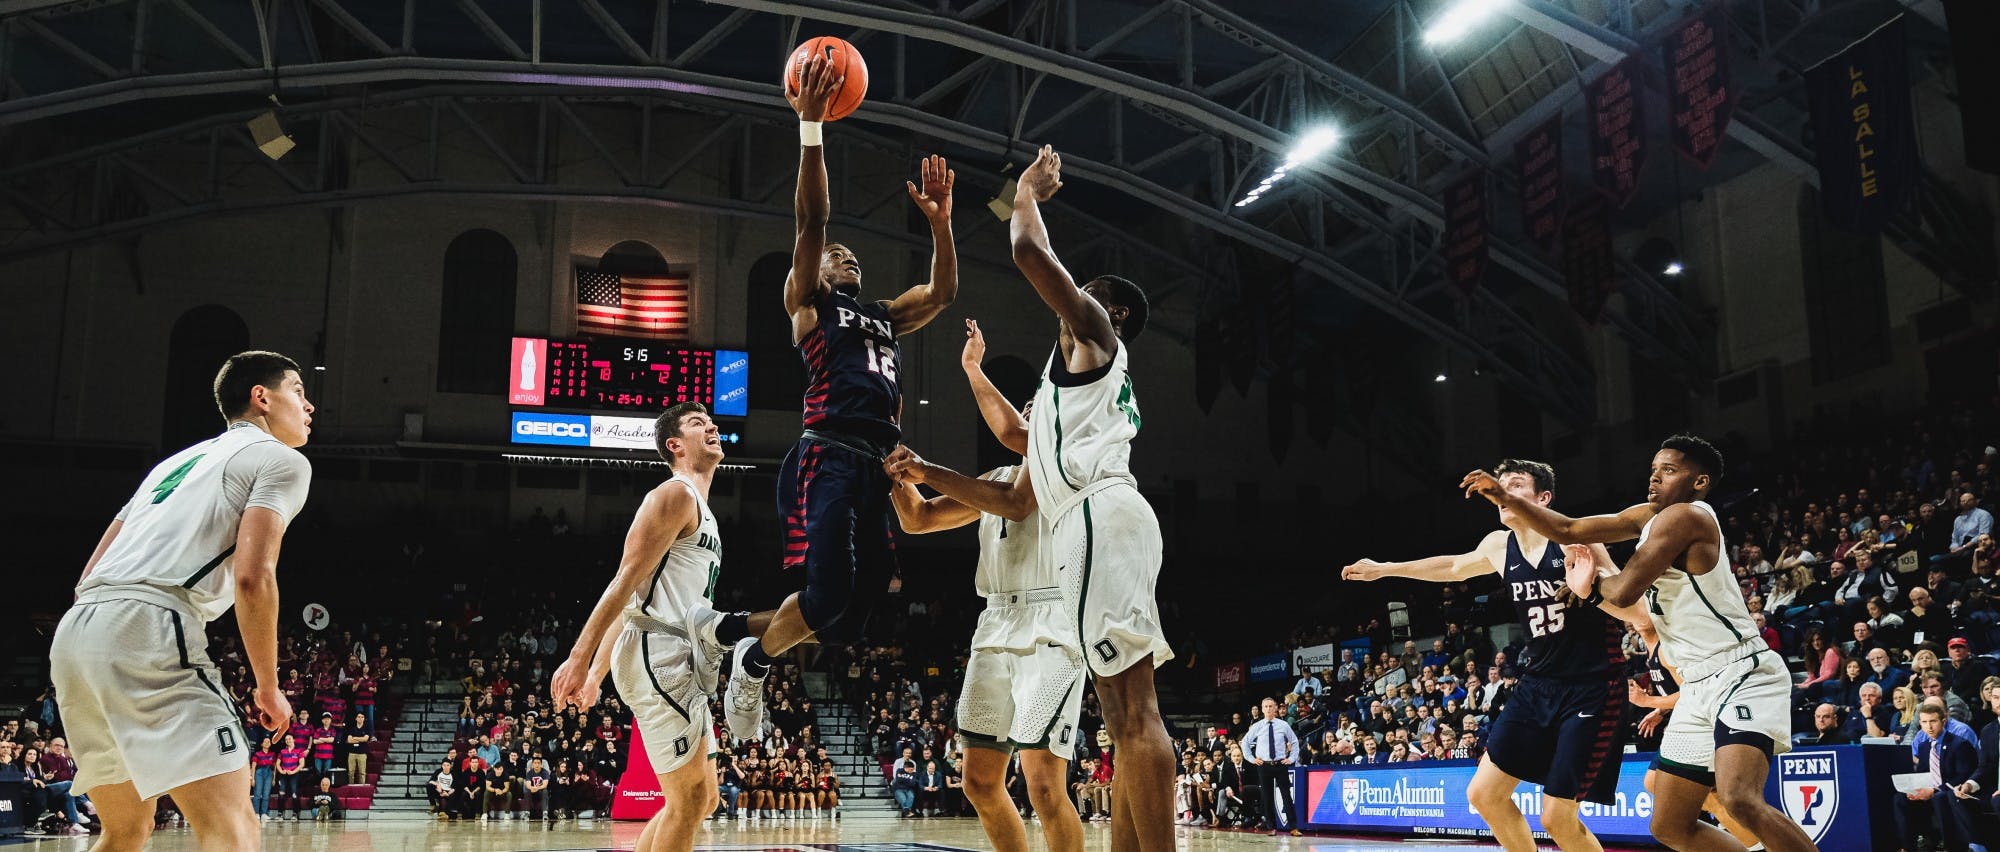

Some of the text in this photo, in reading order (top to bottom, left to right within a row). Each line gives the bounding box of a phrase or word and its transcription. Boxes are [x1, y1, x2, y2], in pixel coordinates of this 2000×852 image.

[1850, 65, 1878, 197] LA SALLE
[837, 306, 893, 340] PEN
[623, 348, 648, 361] 5:15
[865, 339, 897, 383] 12
[729, 358, 746, 370] PECO
[600, 368, 611, 381] 18
[514, 393, 539, 402] enjoy
[727, 386, 745, 398] PECO
[151, 453, 206, 504] 4
[1901, 556, 1916, 565] 103
[1528, 602, 1566, 638] 25
[217, 726, 238, 753] D
[1784, 758, 1831, 775] PENN
[1413, 826, 1436, 834] WELCOME
